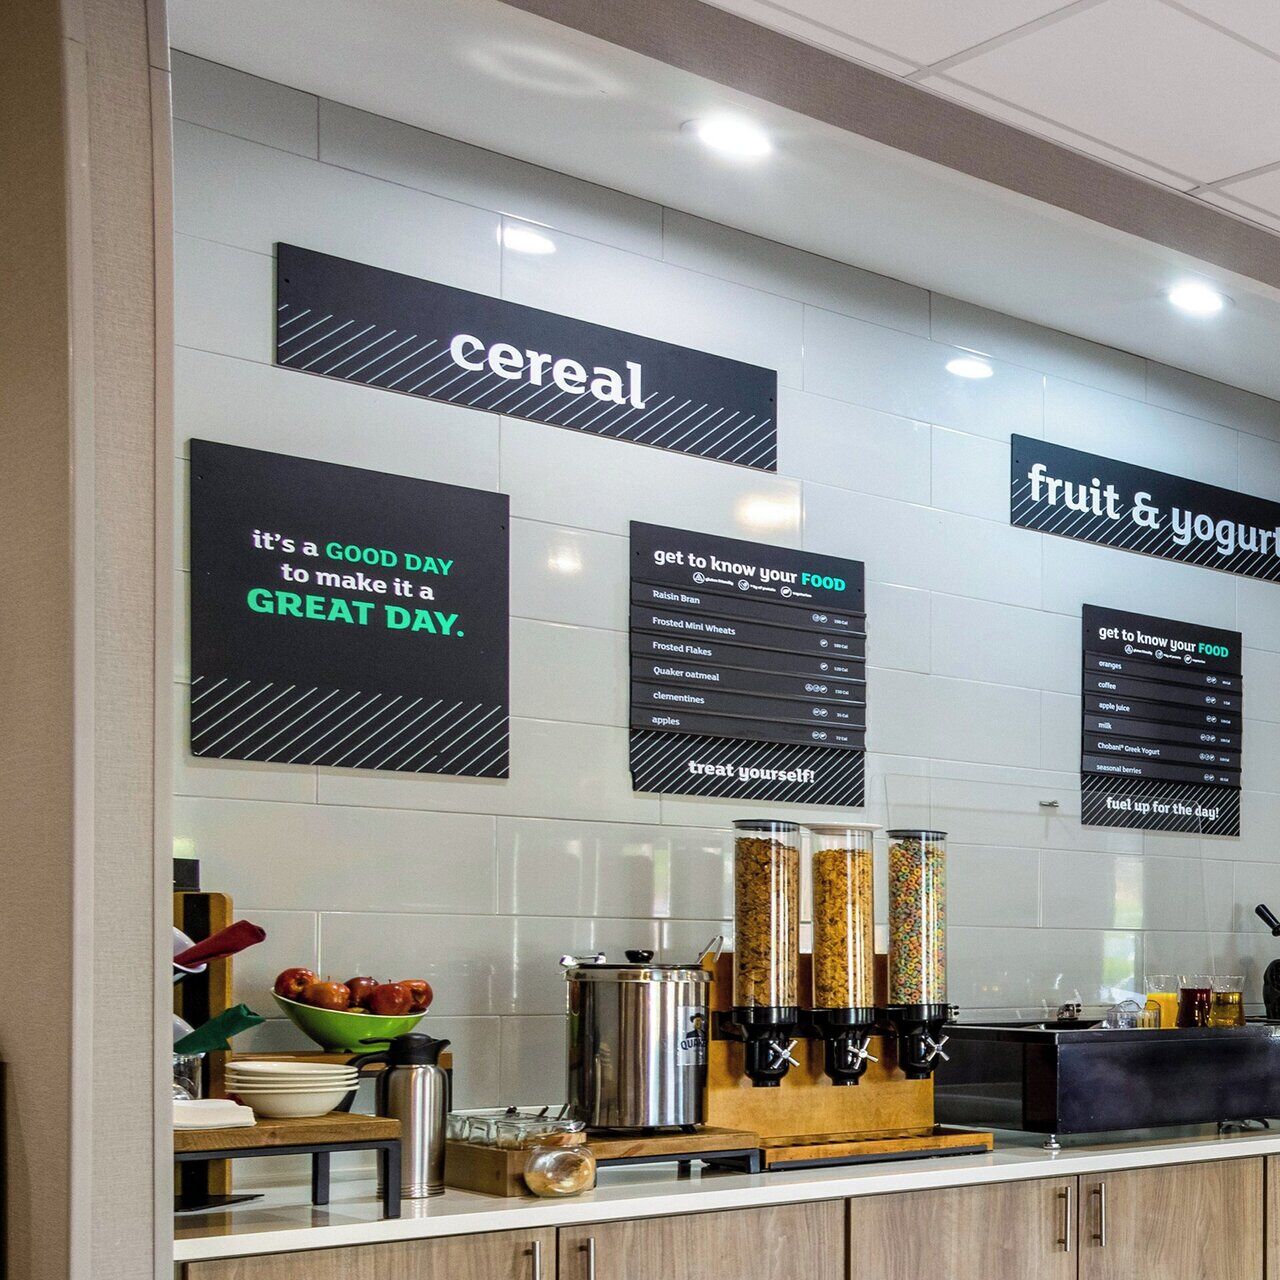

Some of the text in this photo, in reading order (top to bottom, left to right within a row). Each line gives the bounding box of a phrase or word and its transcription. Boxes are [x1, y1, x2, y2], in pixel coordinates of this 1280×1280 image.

[450, 334, 645, 409] cereal
[1028, 463, 1120, 520] fruit
[1132, 491, 1160, 529] &
[303, 541, 319, 557] a
[326, 542, 398, 567] GOOD
[405, 553, 453, 576] DAY
[654, 550, 846, 592] get to know your FOOD
[281, 563, 435, 600] to make it a
[653, 590, 700, 604] Raisin Bran
[247, 588, 464, 637] GREAT DAY.
[652, 617, 736, 636] Frosted Mini Wheats
[653, 642, 712, 657] Frosted Flakes
[1099, 627, 1119, 640] get
[1121, 629, 1135, 642] to
[1136, 631, 1168, 647] know
[1170, 639, 1196, 653] your
[1198, 642, 1229, 658] FOOD
[1098, 661, 1122, 670] oranges
[653, 667, 720, 681] Quaker oatmeal
[1098, 682, 1116, 690] coffee
[653, 691, 705, 704] clementines
[1098, 702, 1130, 712] apple juice
[652, 716, 680, 726] apples
[1098, 722, 1112, 730] milk
[1124, 745, 1141, 753] Greek
[1142, 747, 1160, 756] Yogurt
[688, 760, 815, 783] treat yourself!
[1096, 764, 1142, 774] seasonal berries
[1106, 797, 1219, 820] fuel up for the day!
